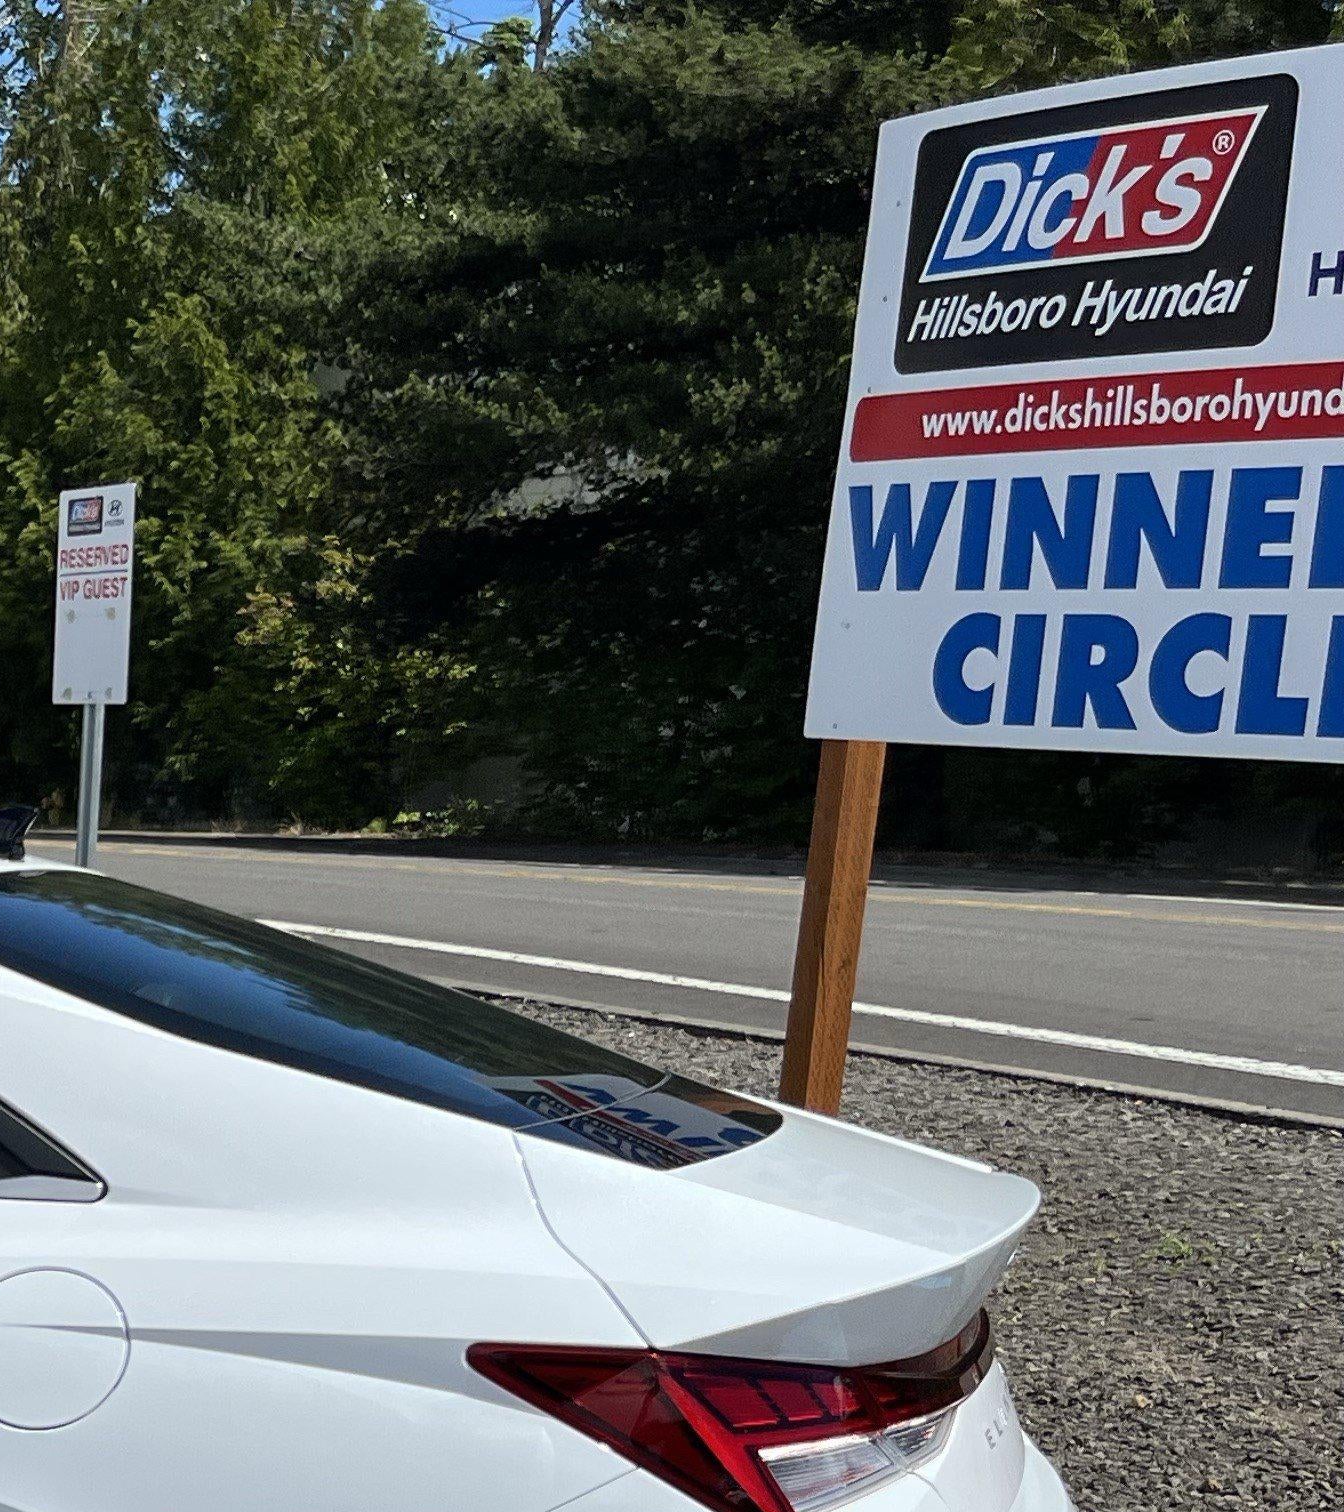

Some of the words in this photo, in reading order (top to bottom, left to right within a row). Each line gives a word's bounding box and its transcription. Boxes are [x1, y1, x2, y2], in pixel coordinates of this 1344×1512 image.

[943, 133, 1213, 261] Dick's
[907, 291, 1068, 343] Hillsboro
[1070, 266, 1254, 337] Hyundai
[60, 544, 129, 569] RESERVED
[59, 579, 80, 602] VIP
[83, 577, 128, 601] GUEST
